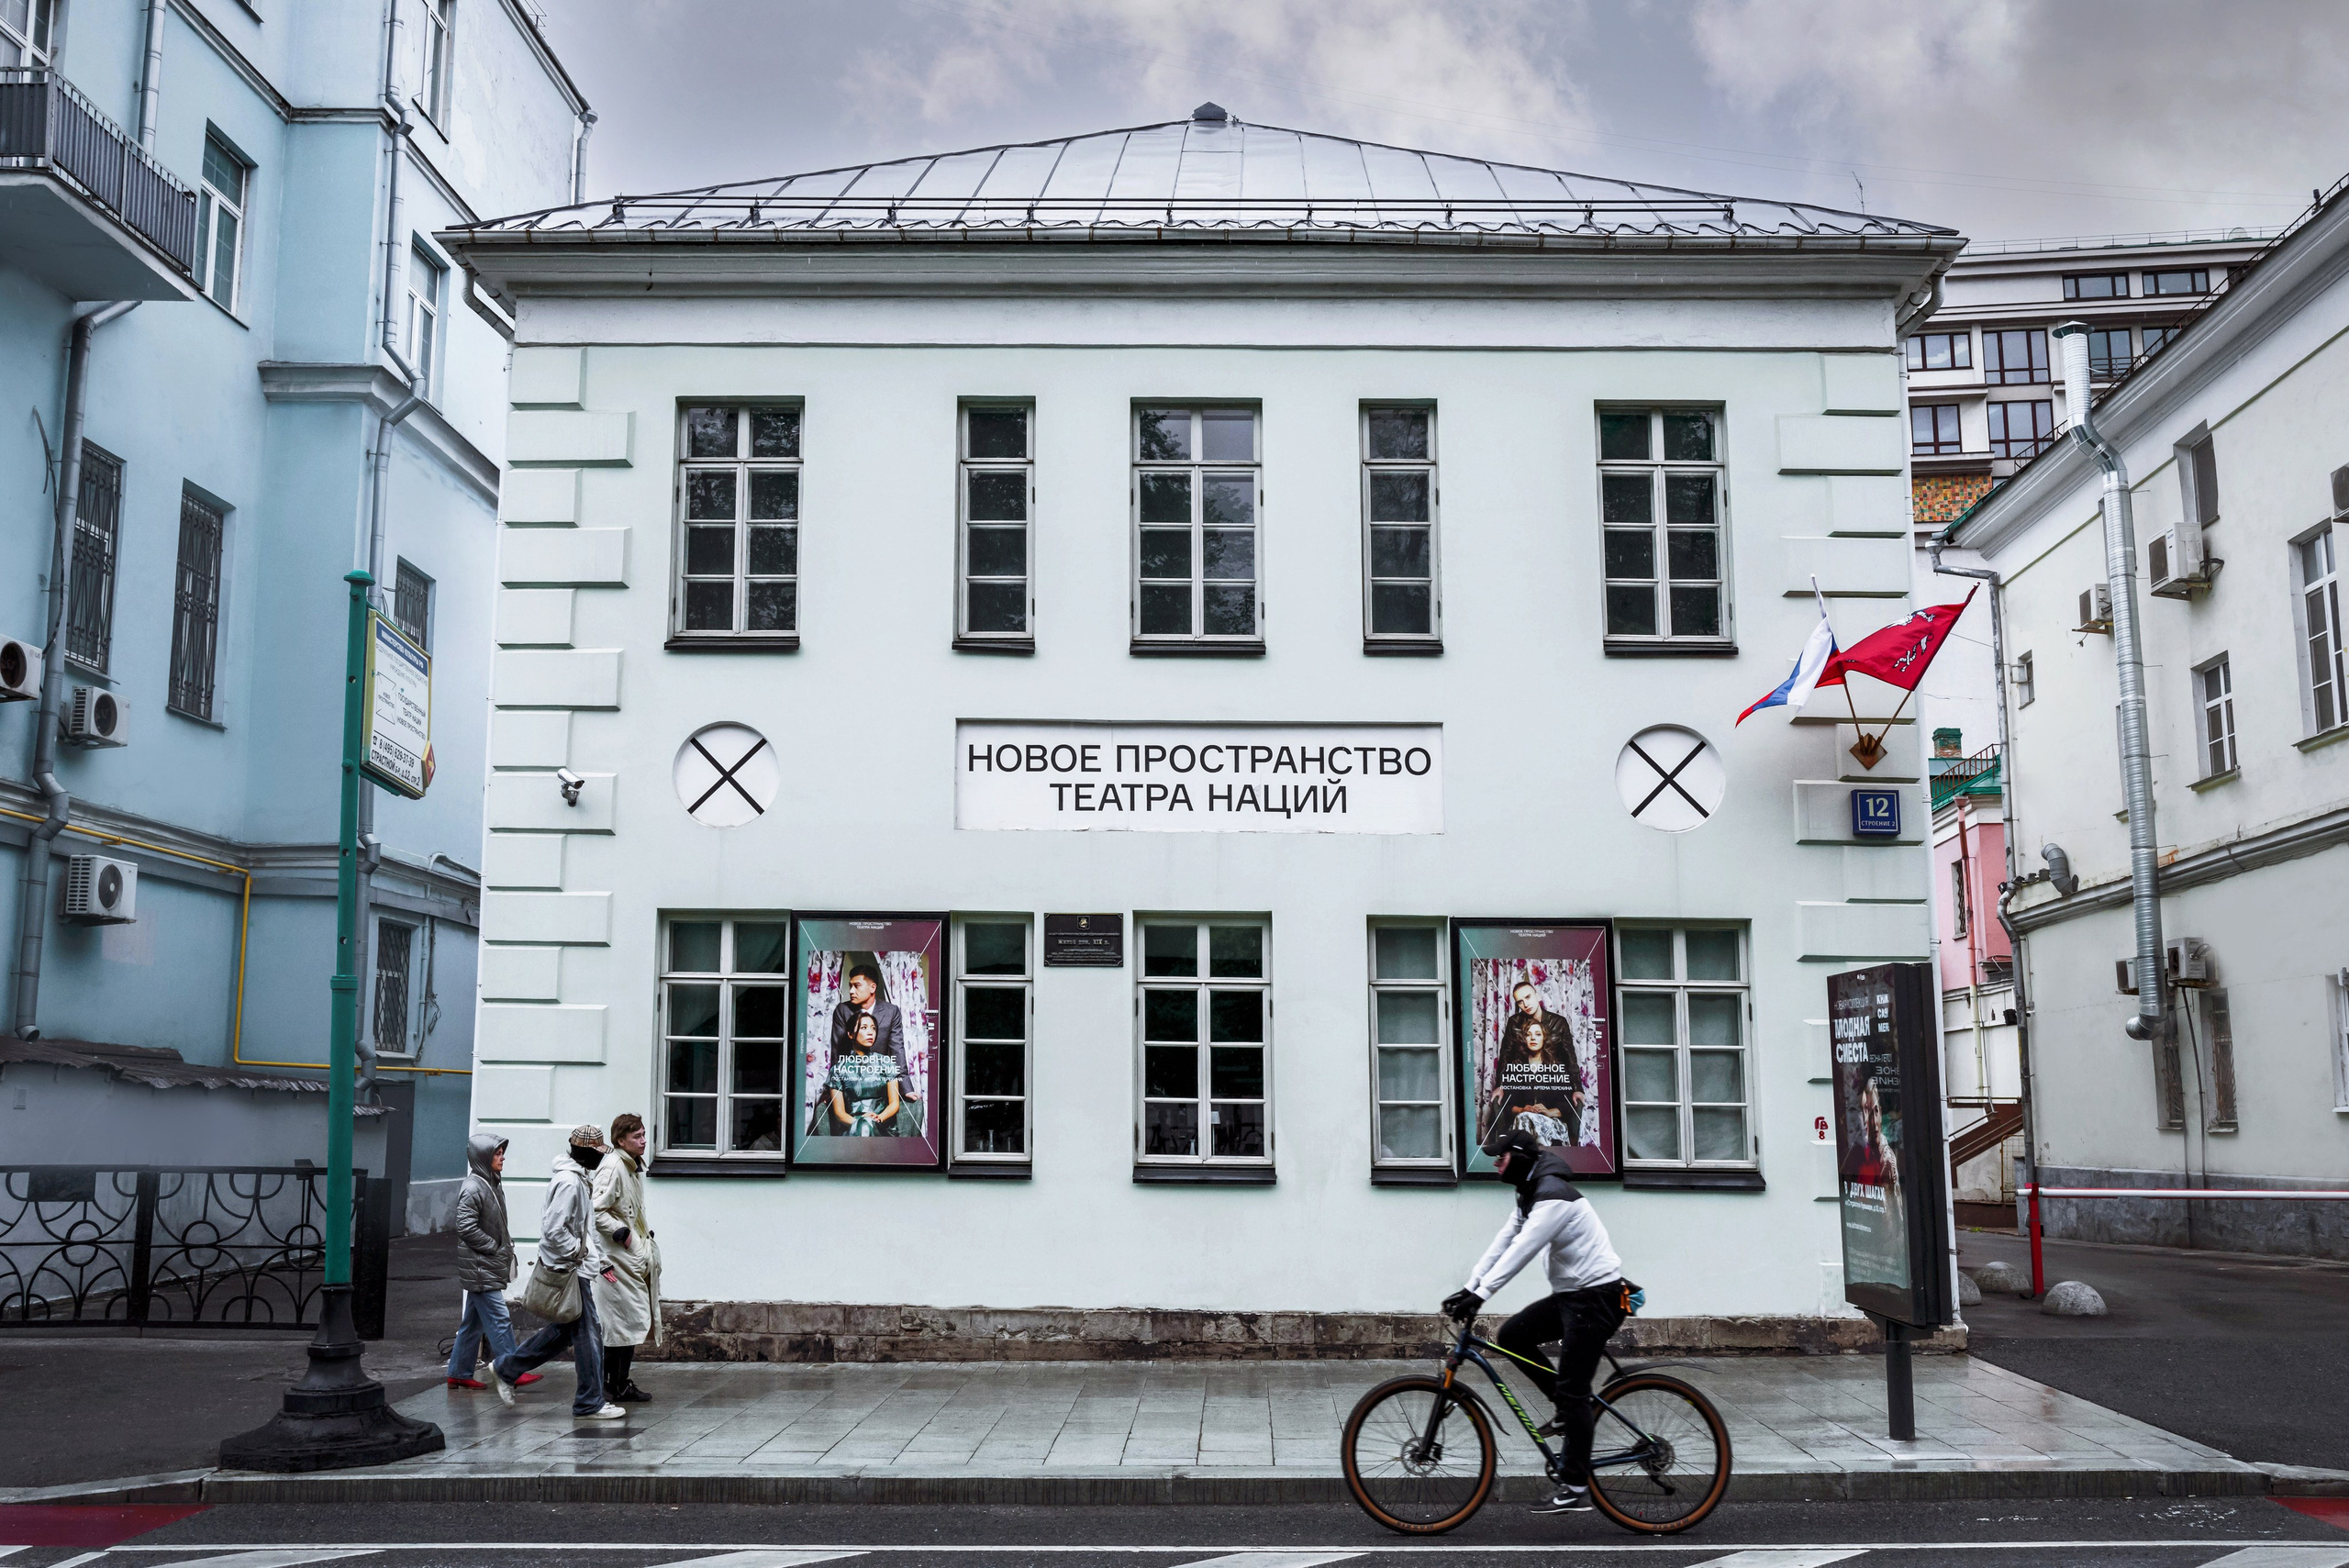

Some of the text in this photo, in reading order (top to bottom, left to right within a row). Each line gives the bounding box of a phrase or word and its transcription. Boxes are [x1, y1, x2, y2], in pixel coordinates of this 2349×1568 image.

[371, 749, 395, 771] СТРАСТНОЙ
[379, 739, 414, 768] 8 (495) 629-37-39
[968, 744, 1431, 776] НОВОЕ ПРОСТРАНСТВО
[1049, 778, 1347, 819] ТЕАТРА НАЦИЙ
[1866, 797, 1889, 817] 12
[1835, 1016, 1870, 1041] МОДНАЯ
[838, 1055, 896, 1064] ЛЮБОВНОЕ
[1836, 1042, 1869, 1063] СИЕСТА
[834, 1066, 900, 1074] НАСТРОЕНИЕ
[1506, 1064, 1565, 1072] ЛЮБОВНОЕ
[1502, 1074, 1570, 1083] НАСТРОЕНИЕ
[1819, 1130, 1825, 1140] 8
[1850, 1182, 1865, 1198] ДВУХ
[1865, 1184, 1886, 1201] ШАГАХ
[1496, 1383, 1545, 1443] MERIDA
